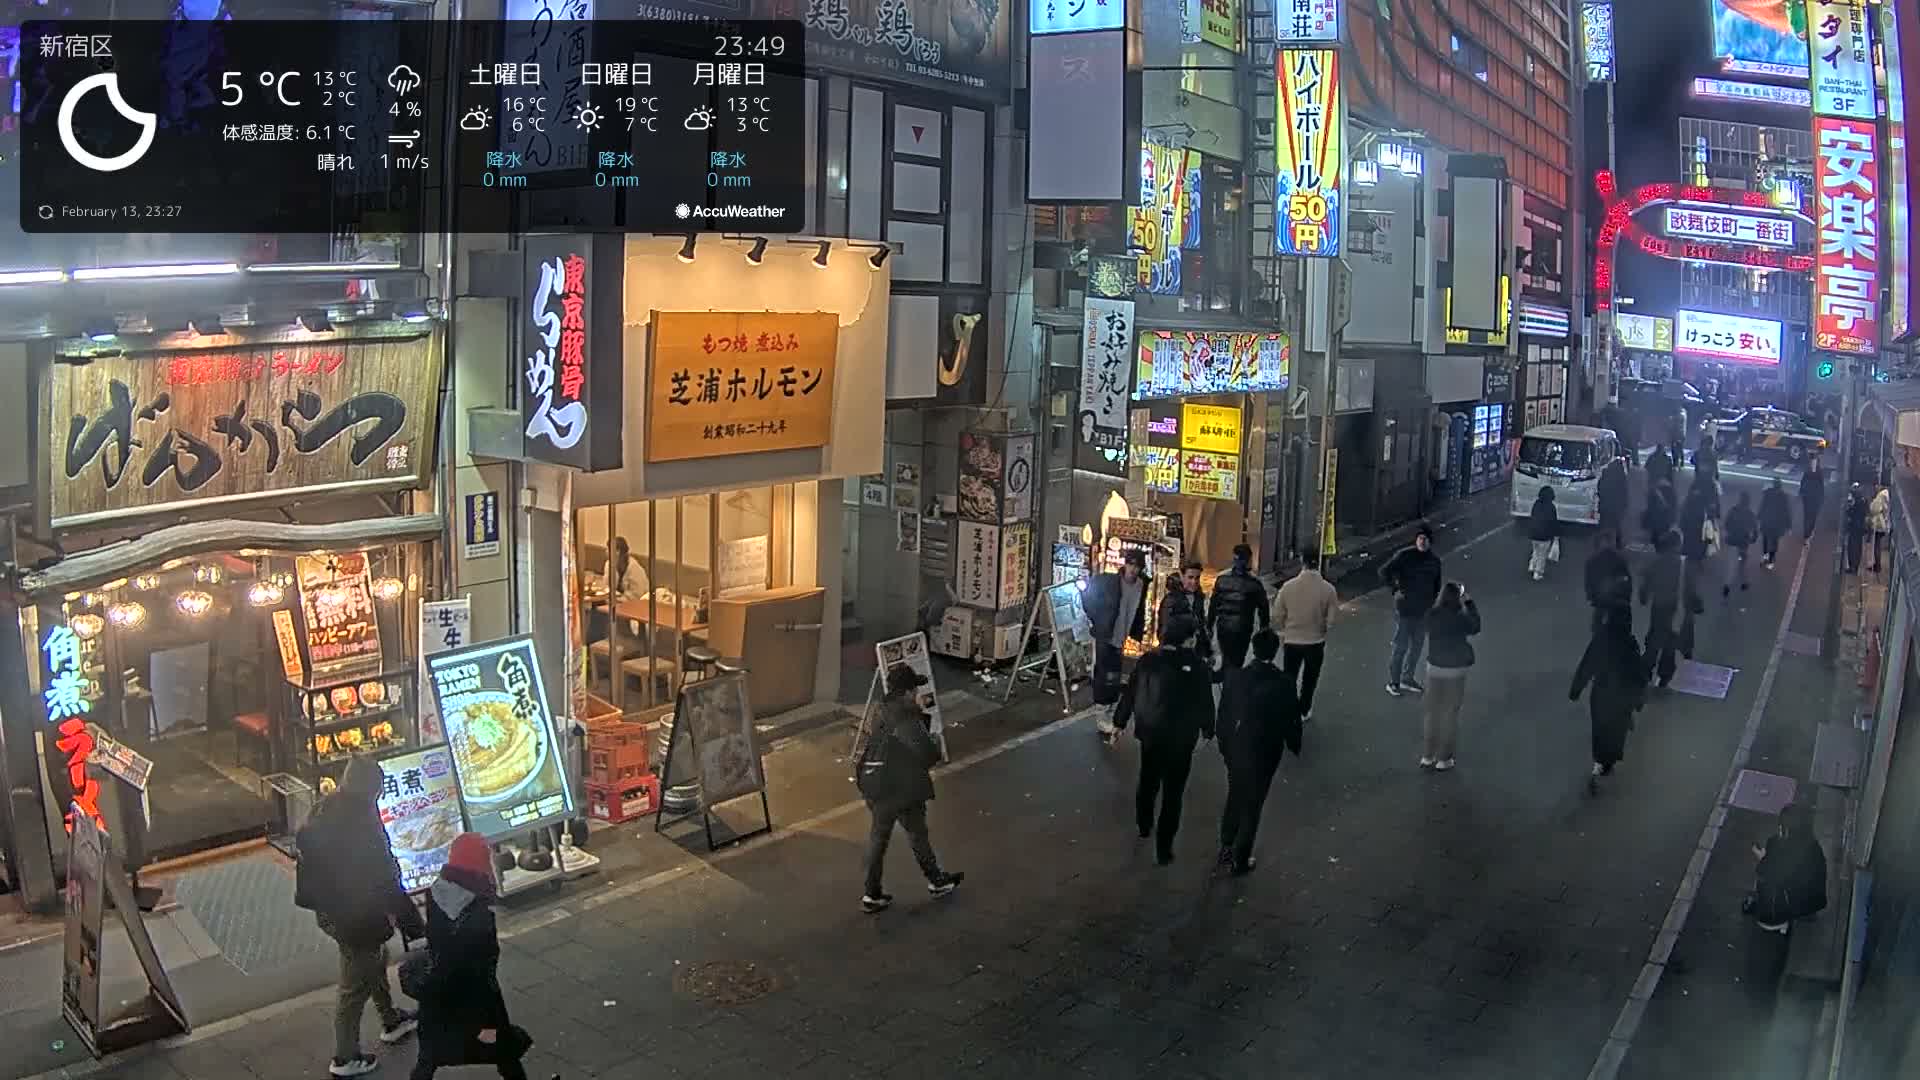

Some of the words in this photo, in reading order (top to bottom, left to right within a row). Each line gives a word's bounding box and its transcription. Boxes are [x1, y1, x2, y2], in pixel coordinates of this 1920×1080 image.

[1817, 0, 1842, 70] タイ
[1589, 64, 1610, 79] 7F
[1296, 53, 1322, 190] ハイボール
[1833, 97, 1856, 112] 3F
[1670, 210, 1790, 242] 歌舞伎町一番街
[1818, 126, 1877, 331] 安楽亭
[560, 254, 585, 400] 東京豚骨
[702, 334, 748, 354] もつ焼
[756, 332, 802, 353] 煮込み
[1817, 332, 1837, 348] 2F
[1098, 310, 1128, 415] お好み焼き
[668, 366, 824, 407] 芝浦ホルモン
[65, 378, 409, 494] ばんから
[703, 420, 789, 441] 創業昭和二十九年
[1100, 433, 1122, 447] B1F
[308, 621, 377, 647] ハッピーアワー
[42, 625, 91, 721] 角煮
[434, 663, 480, 685] TOKYO
[500, 656, 537, 719] 角煮
[382, 767, 424, 801] 角煮
